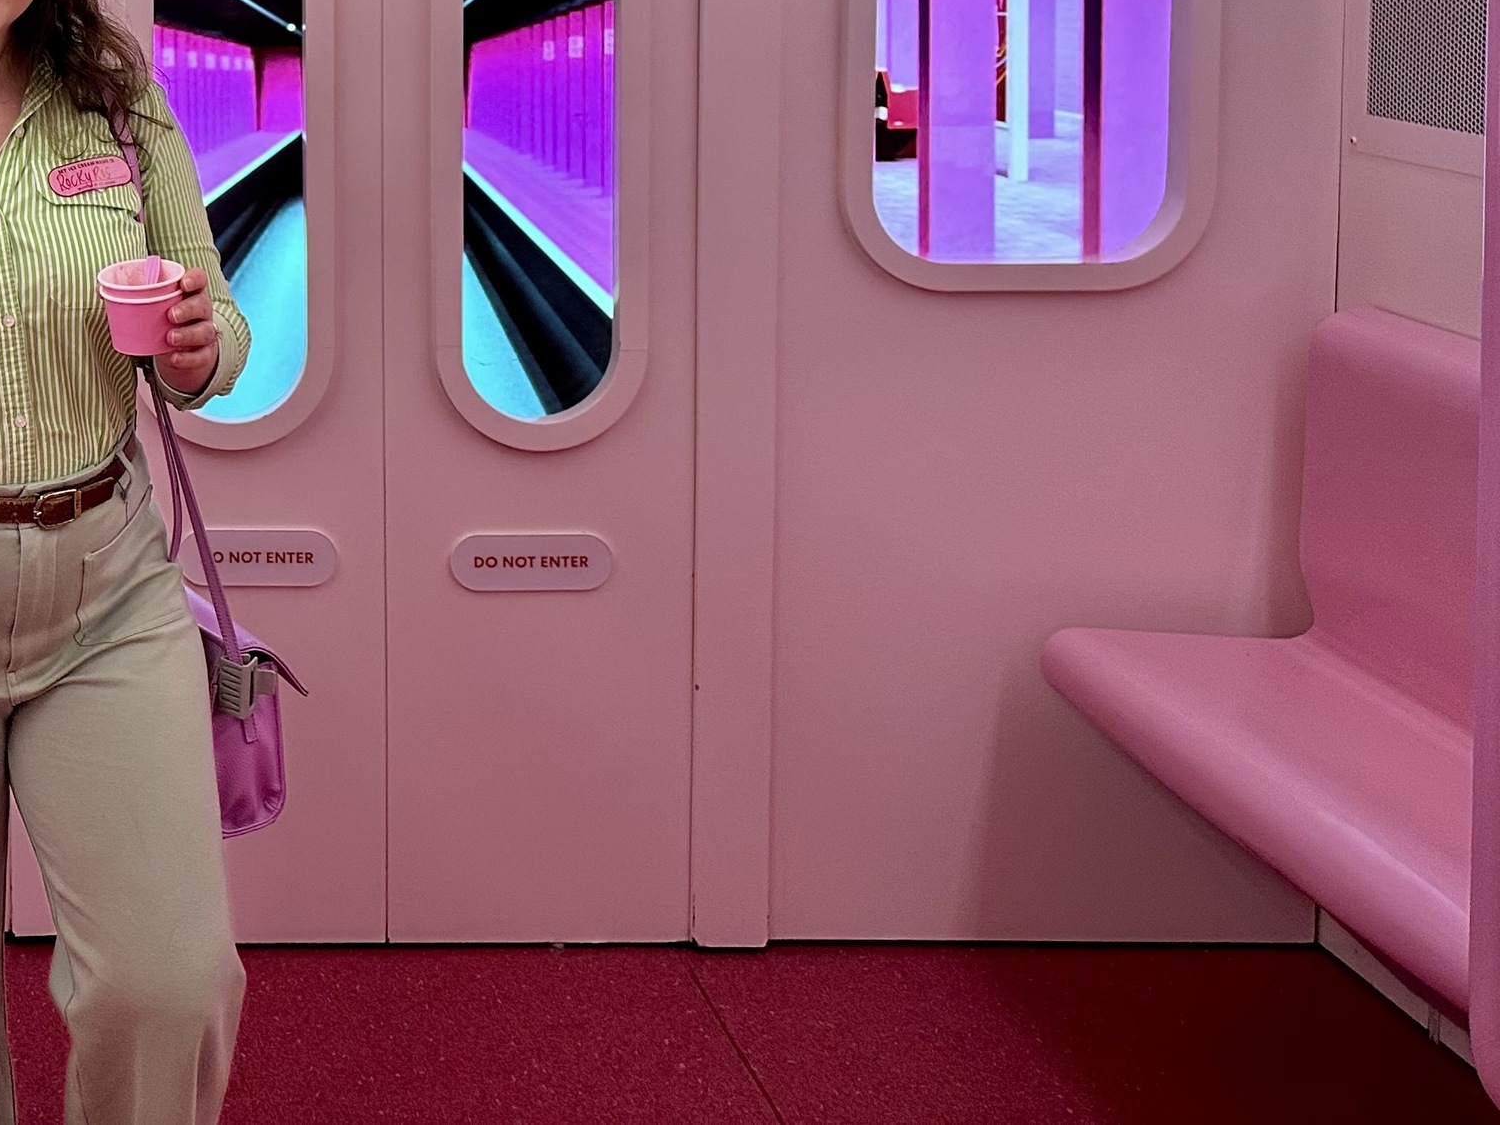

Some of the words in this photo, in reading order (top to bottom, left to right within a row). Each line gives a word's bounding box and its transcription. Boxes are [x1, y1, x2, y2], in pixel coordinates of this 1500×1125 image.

[213, 551, 225, 564] O
[229, 551, 262, 564] NOT
[266, 551, 314, 564] ENTER
[474, 556, 498, 568] DO
[503, 556, 536, 568] NOT
[540, 555, 589, 568] ENTER
